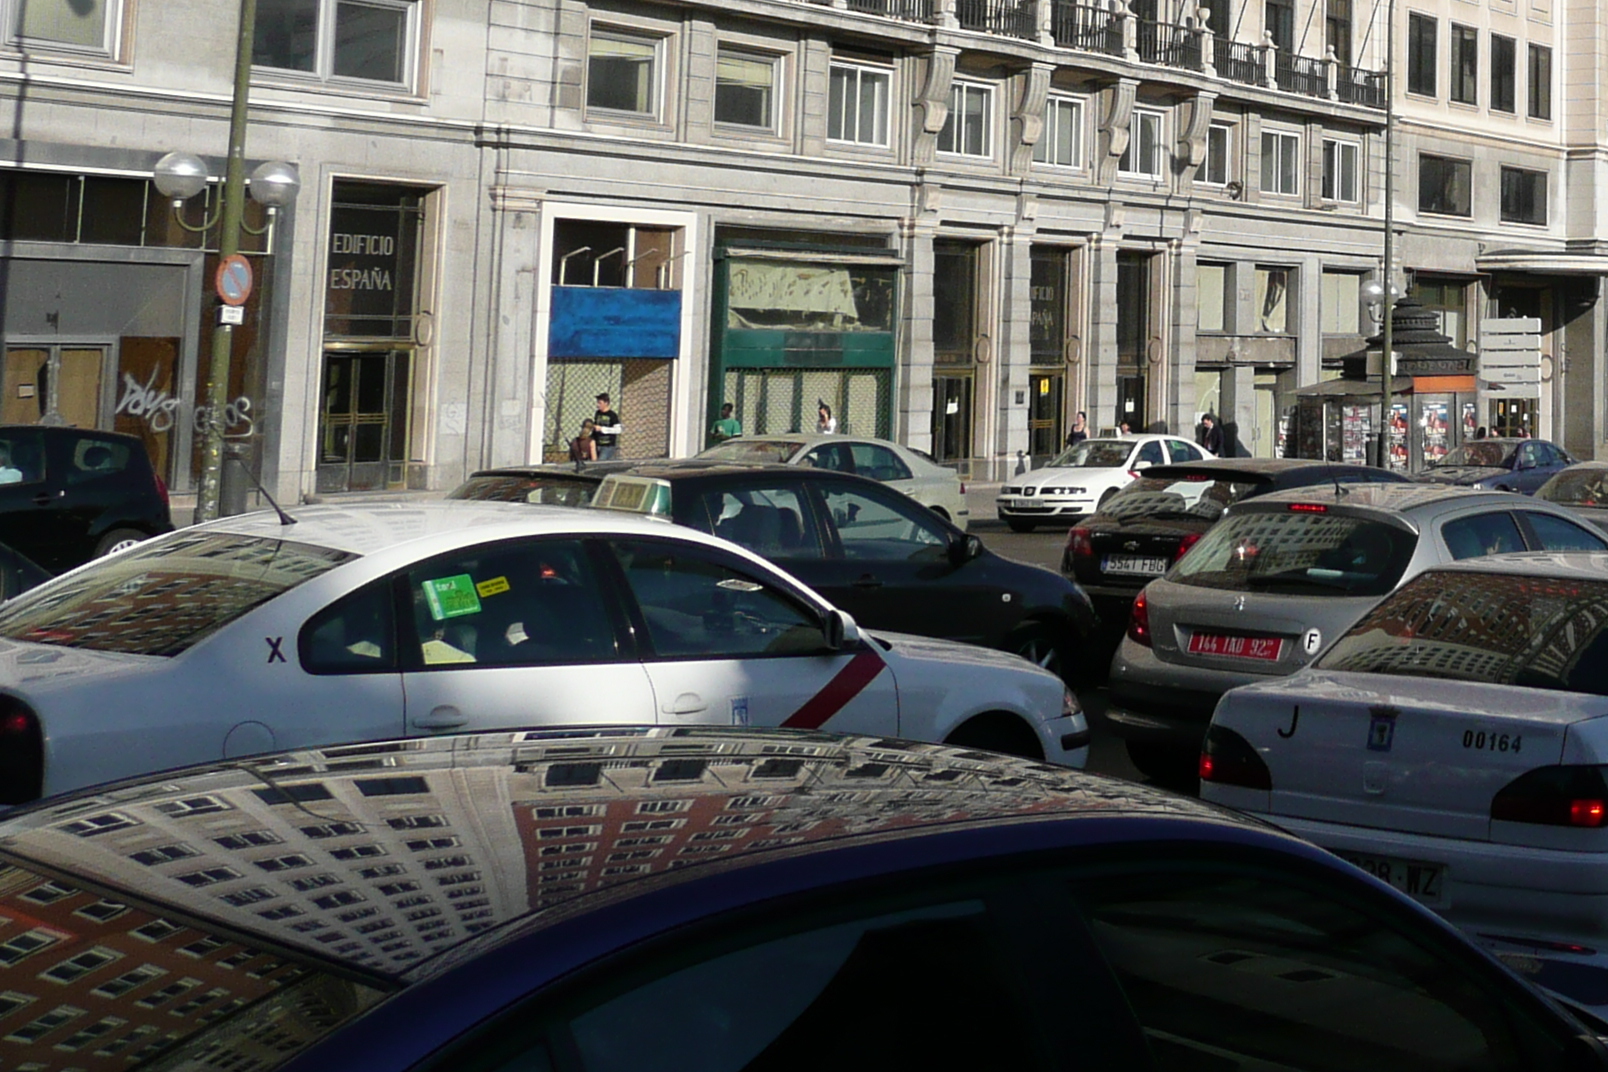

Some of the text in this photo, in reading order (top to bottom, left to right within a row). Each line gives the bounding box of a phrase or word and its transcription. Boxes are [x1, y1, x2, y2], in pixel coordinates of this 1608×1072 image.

[333, 233, 394, 255] EDIFICIO
[331, 267, 392, 290] ESPAÑA
[265, 637, 287, 664] X
[1306, 633, 1318, 650] F
[1277, 705, 1299, 739] J
[1463, 729, 1522, 753] 00164
